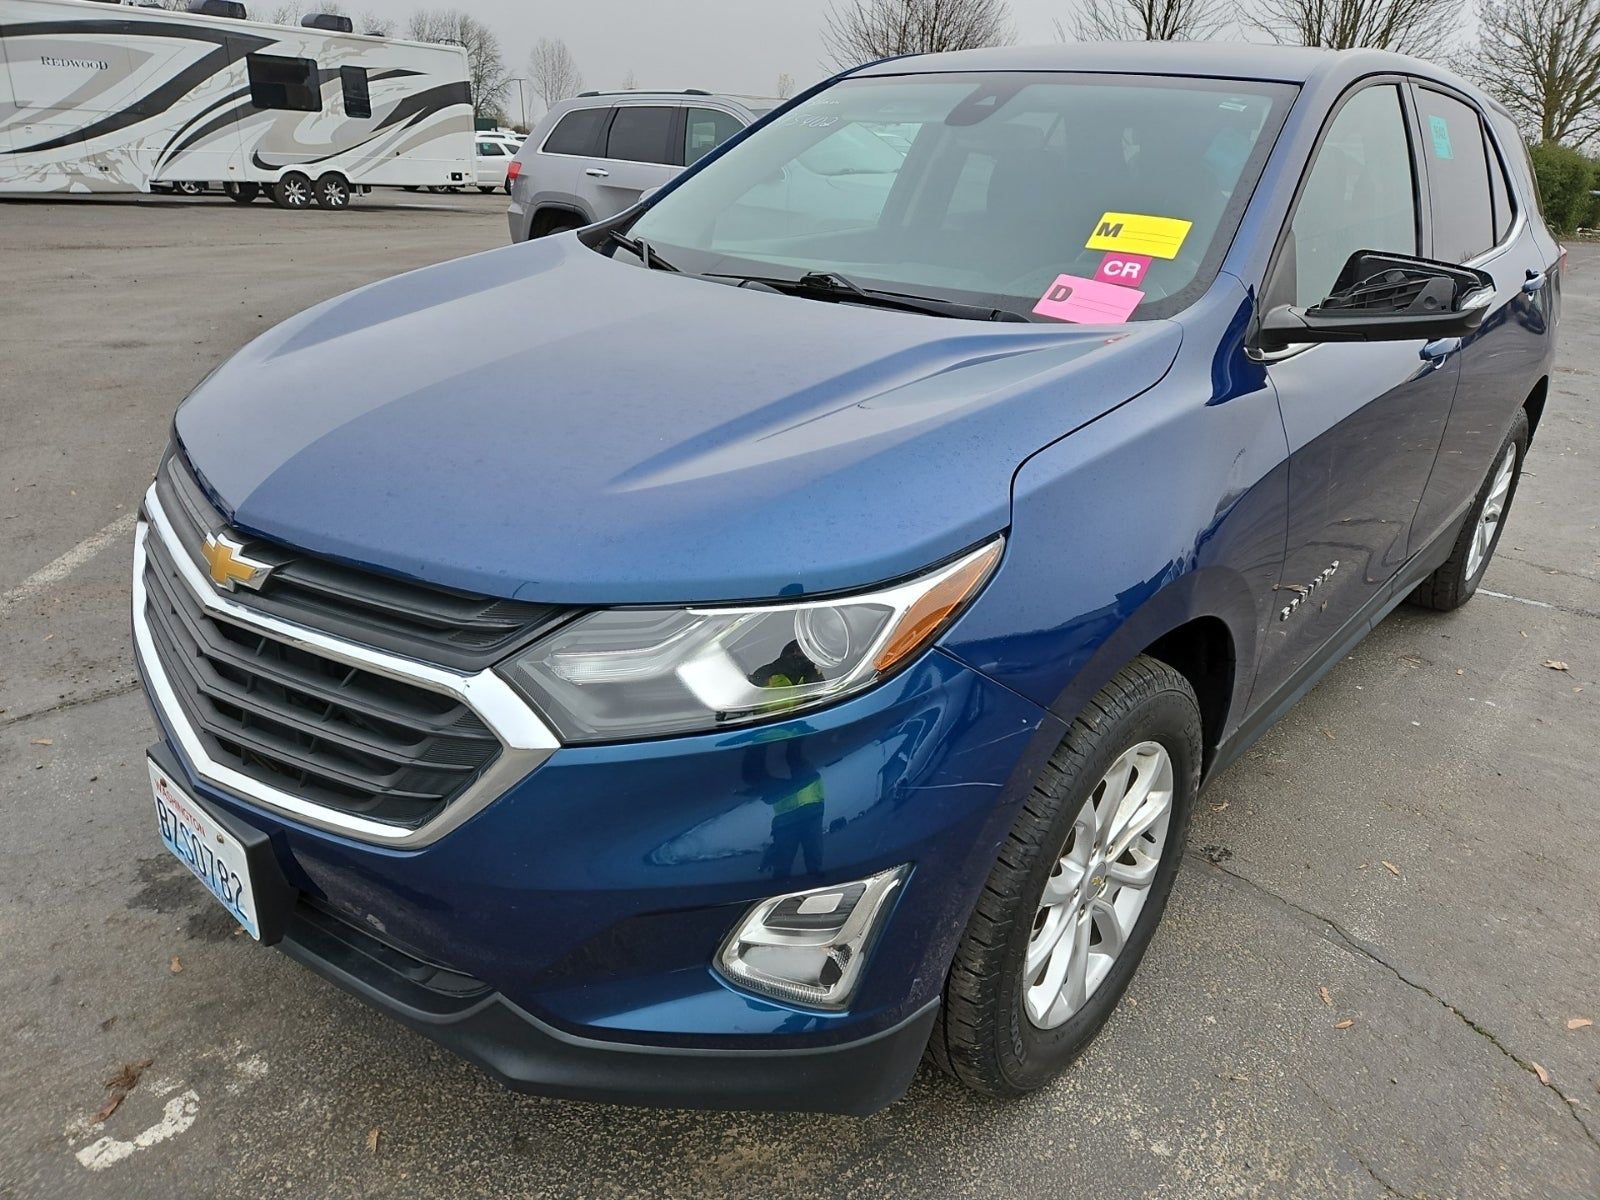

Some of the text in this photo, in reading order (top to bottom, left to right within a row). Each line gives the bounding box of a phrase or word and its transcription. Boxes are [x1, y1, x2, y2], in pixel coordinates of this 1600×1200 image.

[41, 56, 108, 70] REDWOOD
[1096, 222, 1124, 238] M
[1103, 260, 1142, 279] CR
[1047, 284, 1074, 303] D
[156, 796, 248, 921] BZS0782
